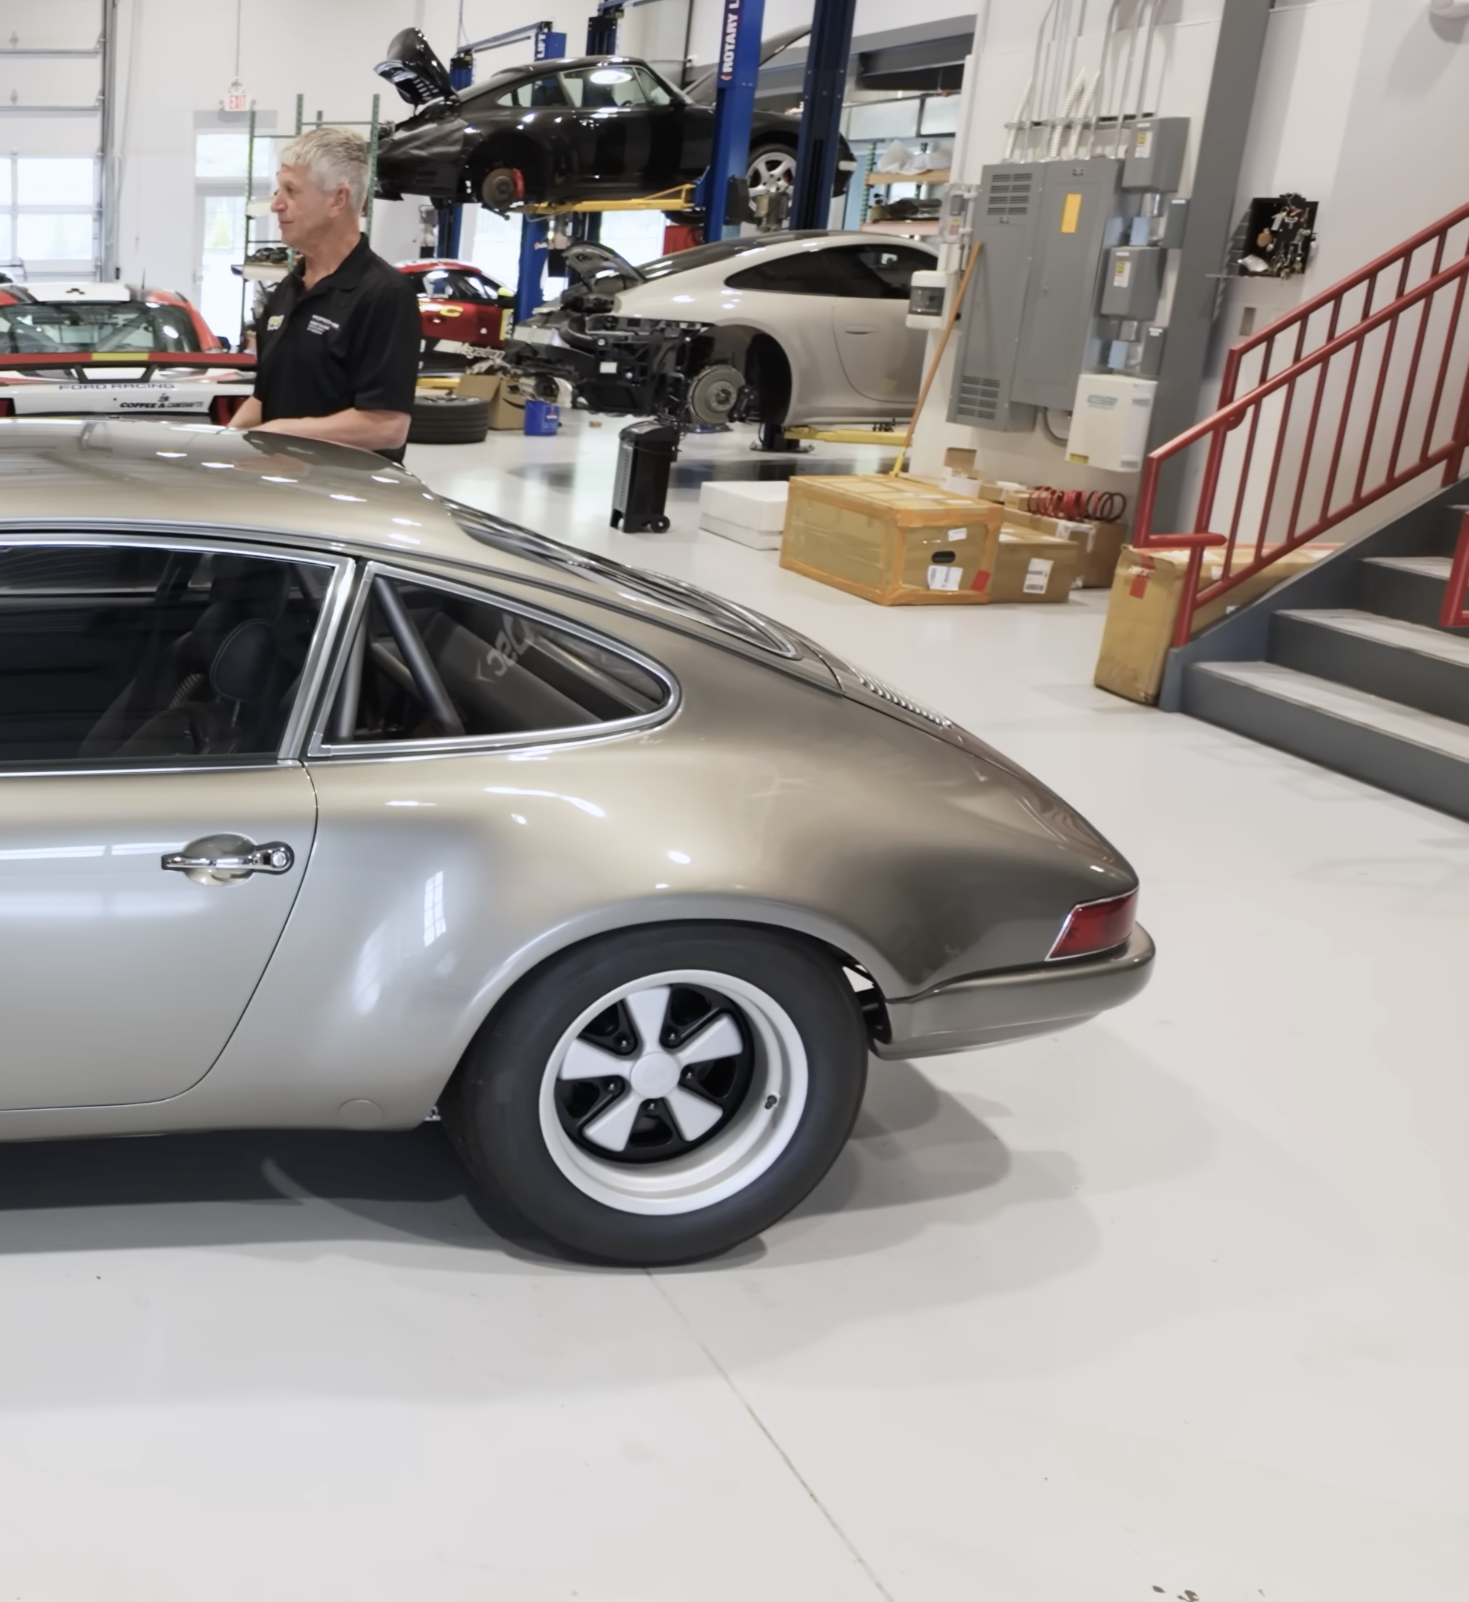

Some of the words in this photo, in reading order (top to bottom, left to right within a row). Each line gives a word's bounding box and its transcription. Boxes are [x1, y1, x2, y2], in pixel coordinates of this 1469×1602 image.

[536, 34, 547, 58] LIFT
[722, 13, 739, 73] ROTARY
[229, 94, 247, 110] EXIT
